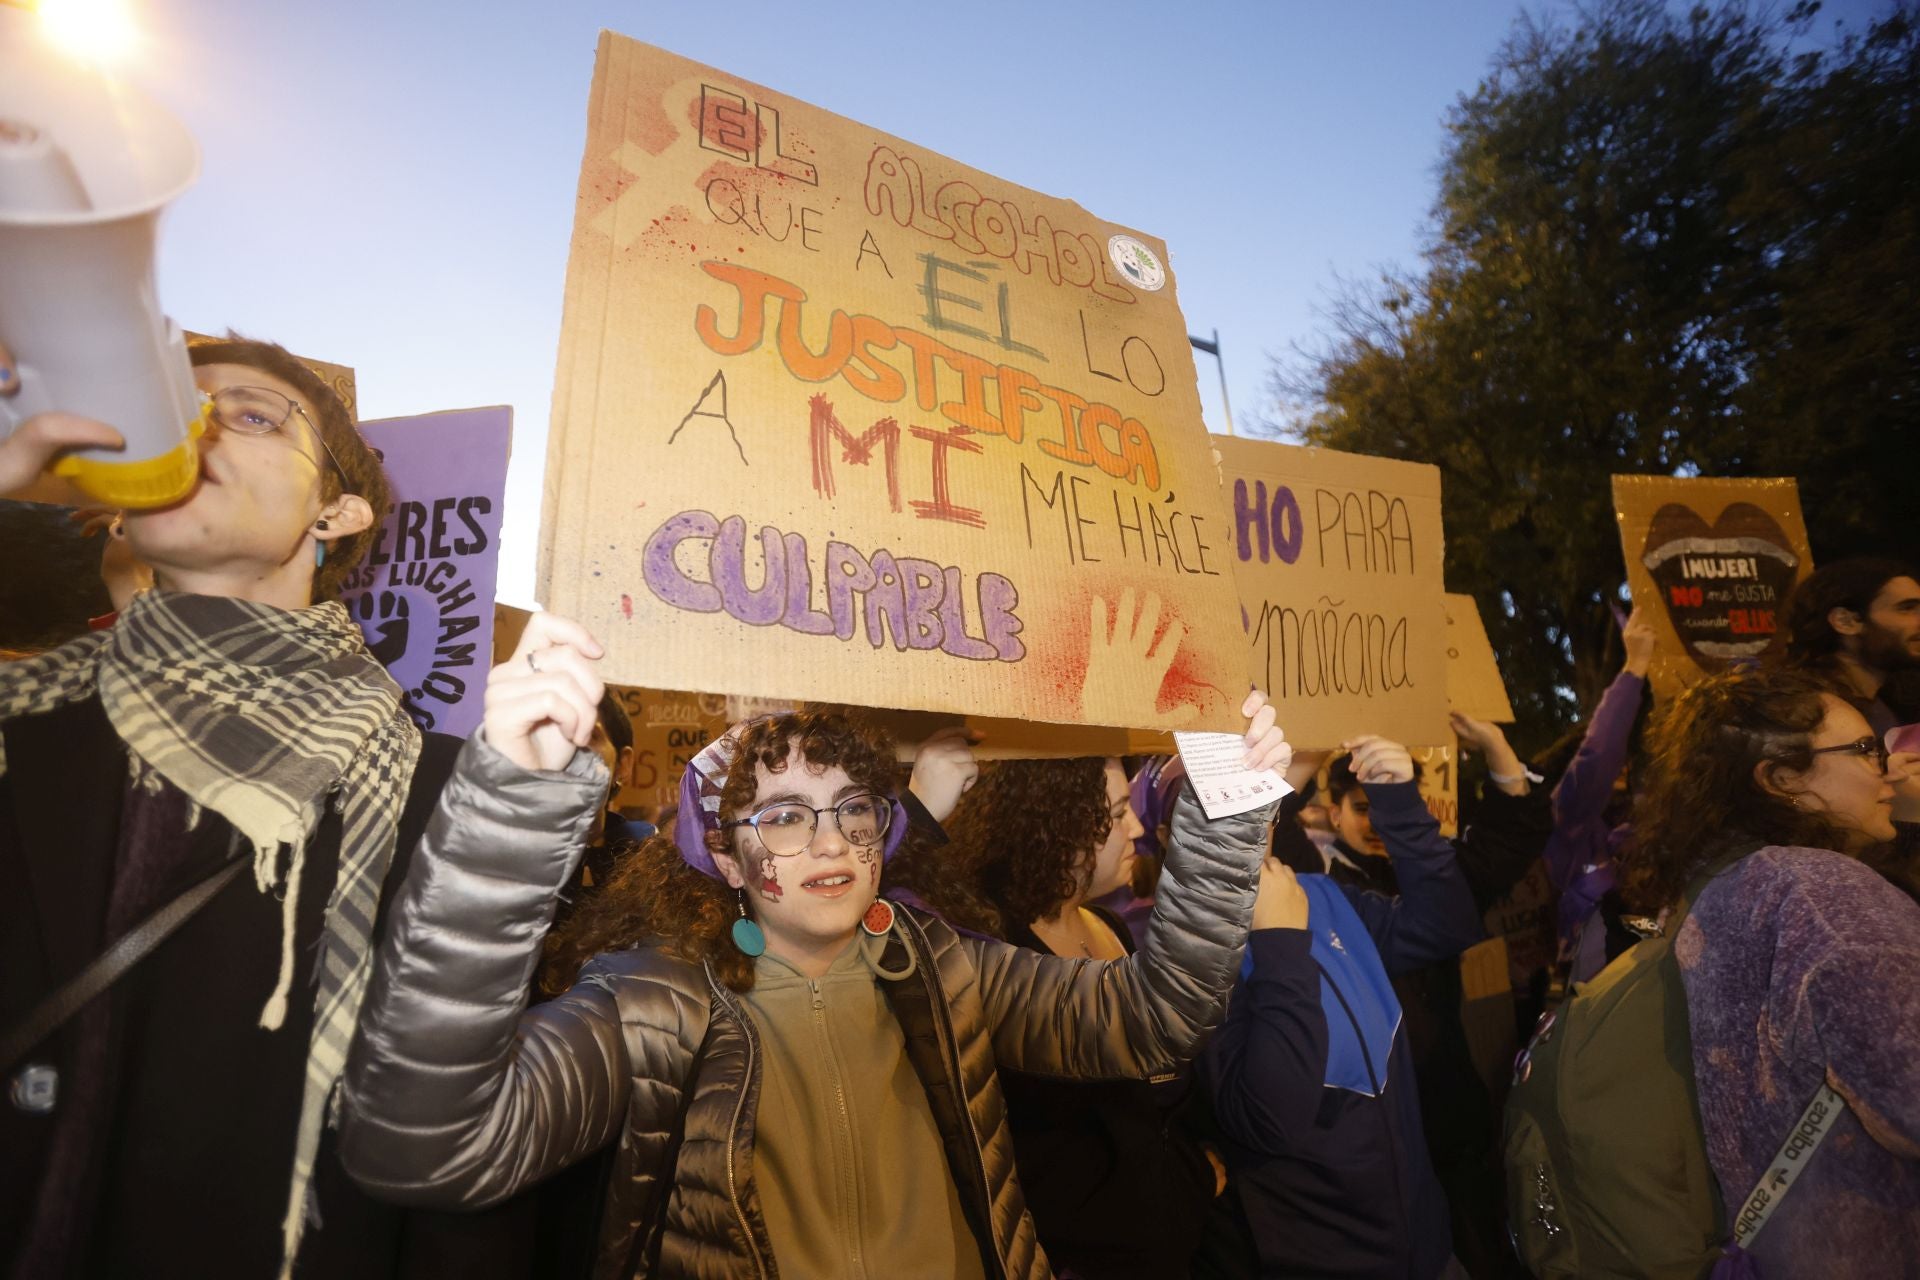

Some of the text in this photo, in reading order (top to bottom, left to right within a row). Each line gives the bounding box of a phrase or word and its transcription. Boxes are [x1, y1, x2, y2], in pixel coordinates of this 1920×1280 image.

[699, 83, 819, 188] EL
[864, 146, 1137, 304] ALCOHOL
[706, 178, 824, 252] QUE
[856, 230, 893, 278] A
[1080, 309, 1165, 396] LO
[362, 496, 491, 567] ERES
[668, 370, 749, 466] A
[1021, 462, 1101, 566] ME
[1316, 489, 1414, 575] PARA
[642, 510, 1027, 663] CULPABLE
[1252, 595, 1415, 698] mañana
[1670, 585, 1704, 607] NO
[1734, 583, 1775, 603] GUSTA
